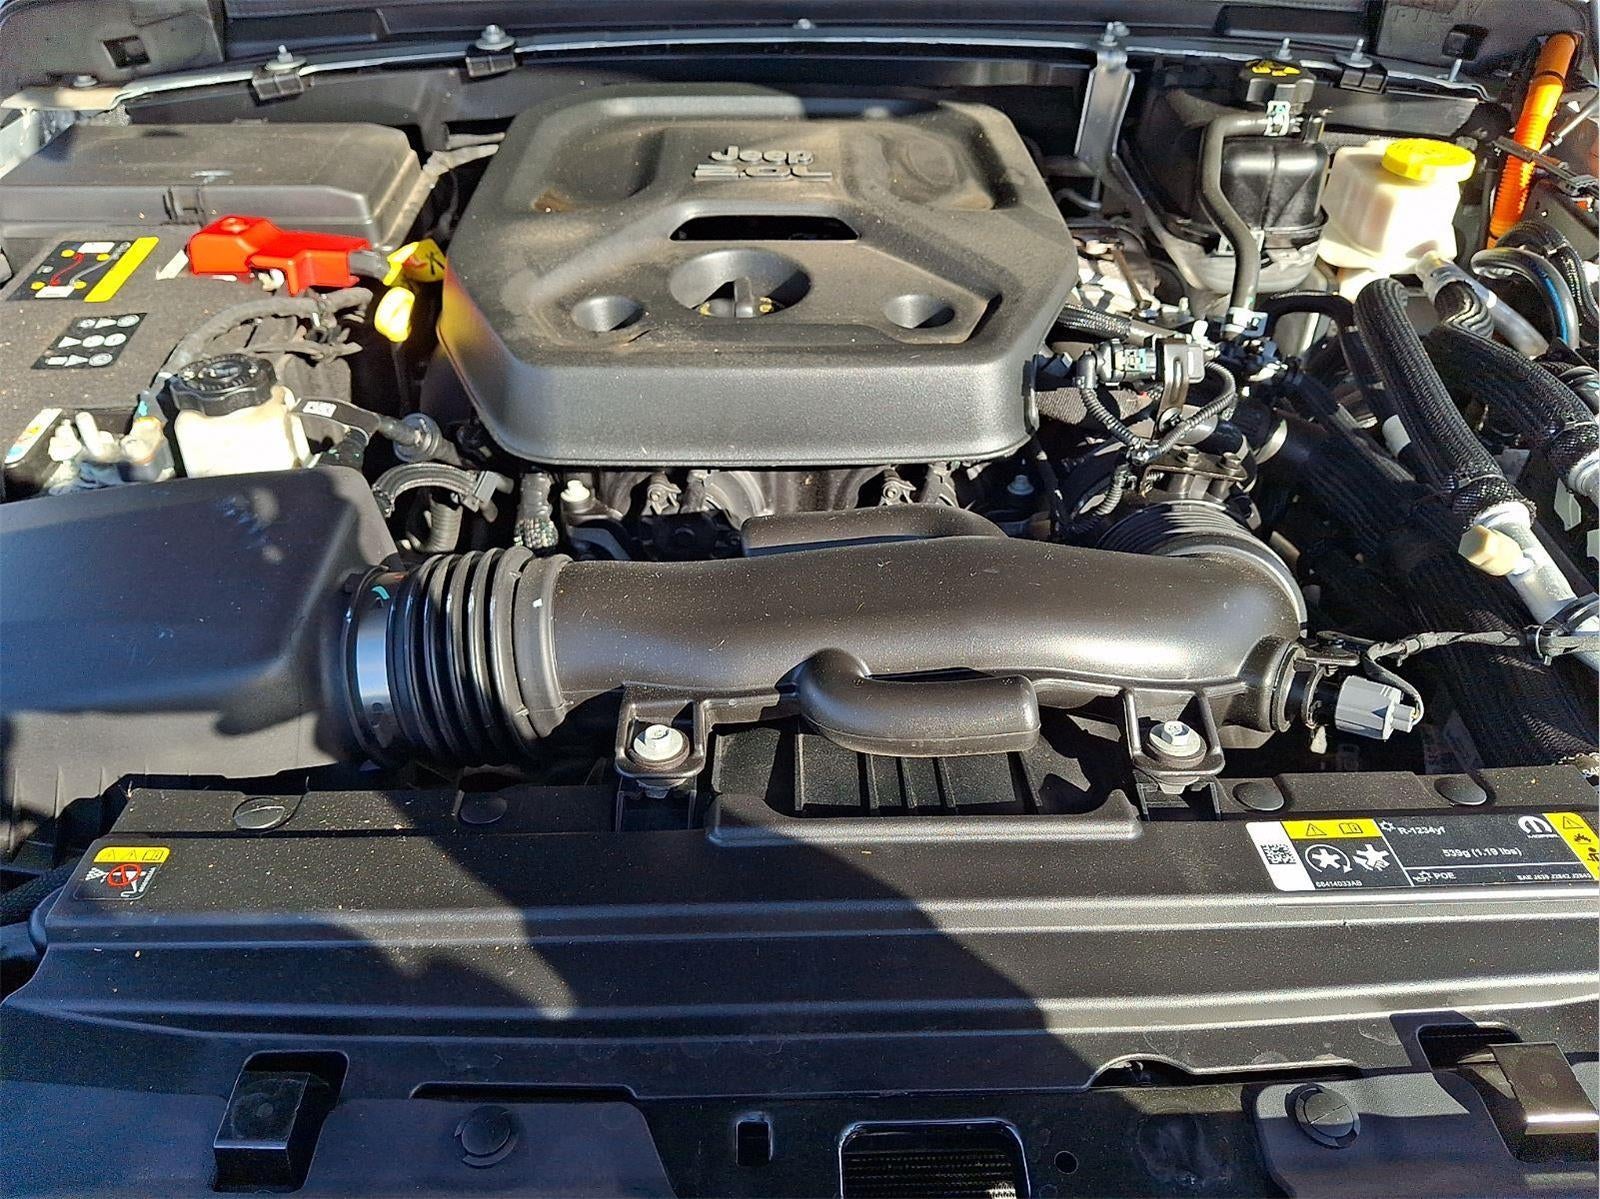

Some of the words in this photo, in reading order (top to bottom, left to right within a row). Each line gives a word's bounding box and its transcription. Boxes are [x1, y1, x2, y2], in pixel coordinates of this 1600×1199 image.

[709, 145, 815, 164] Jeep
[1441, 848, 1471, 858] 539g
[1471, 848, 1499, 858] (1.19
[1499, 846, 1523, 857] lbs)
[1432, 871, 1457, 880] POE
